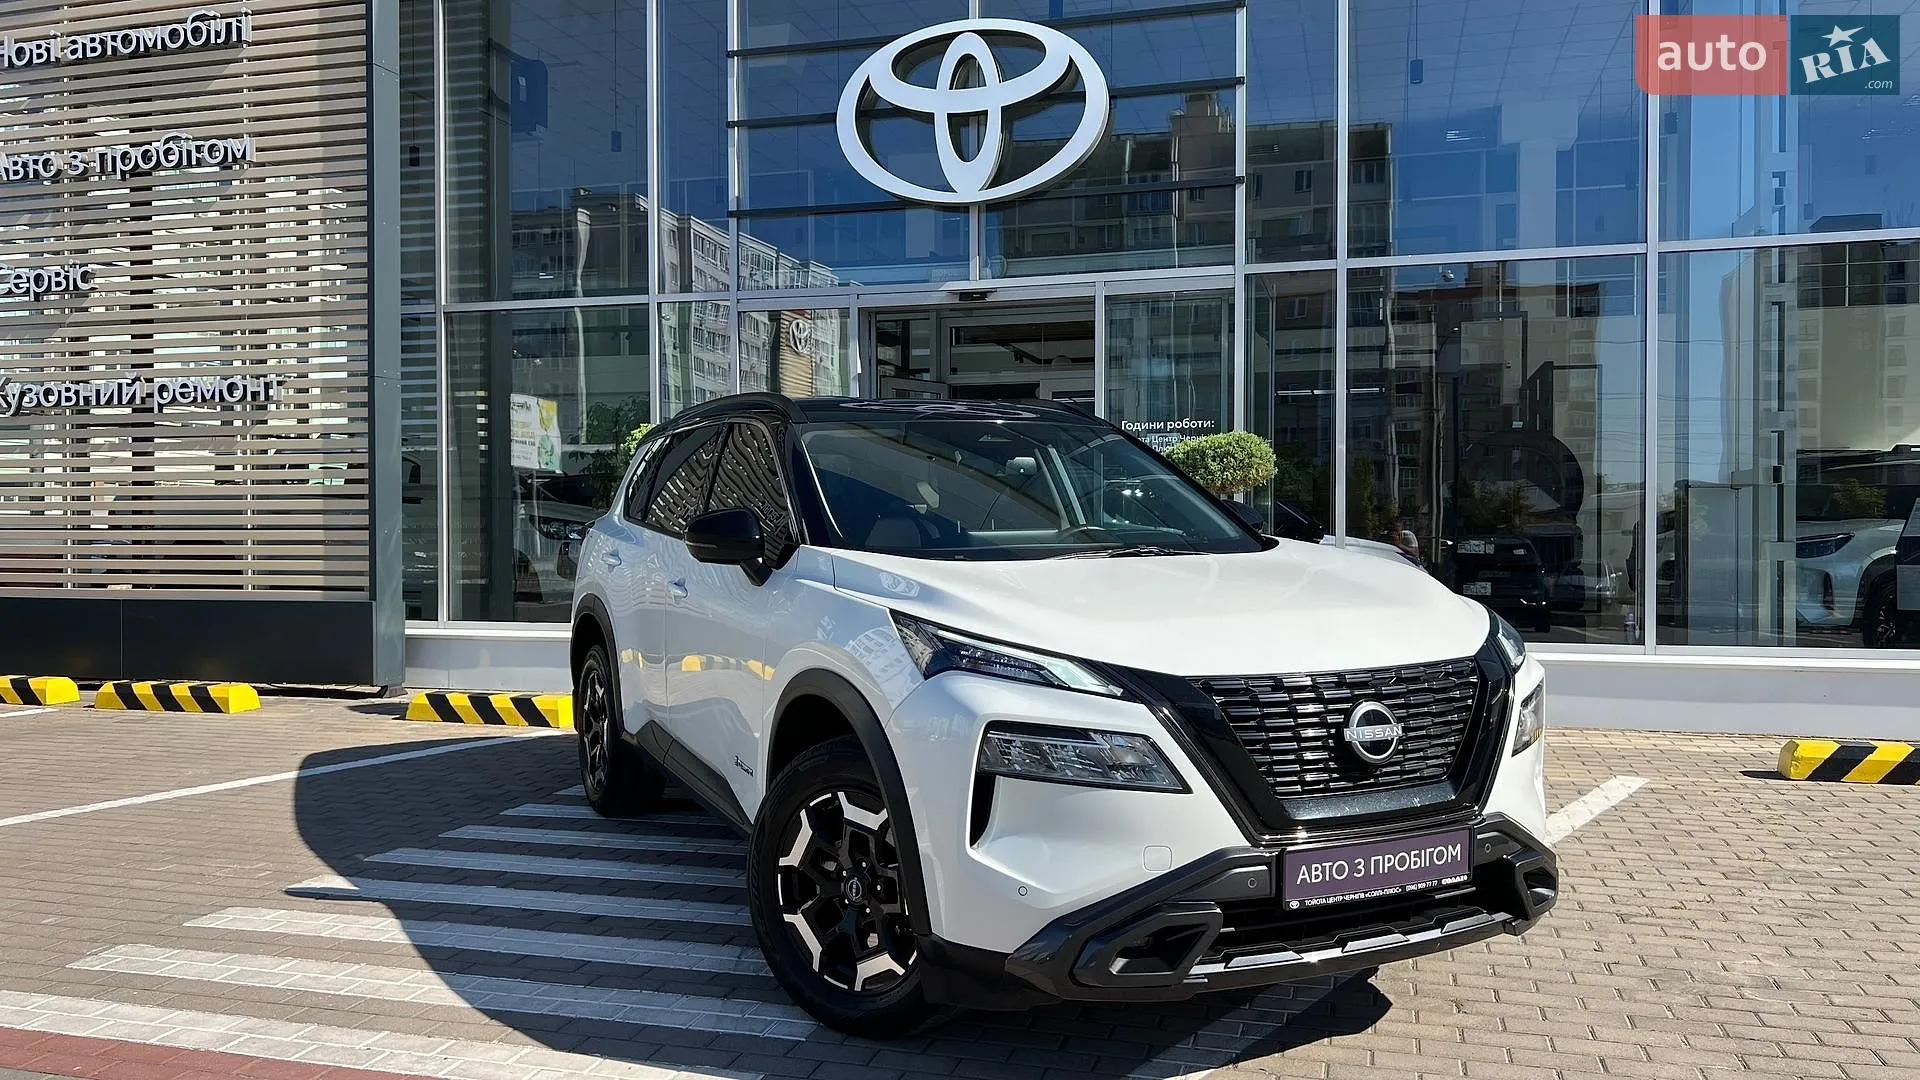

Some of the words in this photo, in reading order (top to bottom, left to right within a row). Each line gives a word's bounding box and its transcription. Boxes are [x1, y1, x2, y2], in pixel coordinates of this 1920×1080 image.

[66, 6, 252, 60] автомобілі
[68, 151, 88, 176] з
[96, 132, 256, 179] пробігом
[154, 376, 284, 413] ремонт
[1121, 420, 1164, 431] Години
[1167, 418, 1215, 431] роботи:
[1346, 726, 1402, 740] NISSAN
[1297, 860, 1349, 885] АВТО
[1353, 858, 1365, 878] З
[1370, 843, 1461, 876] ПРОБІГОМ
